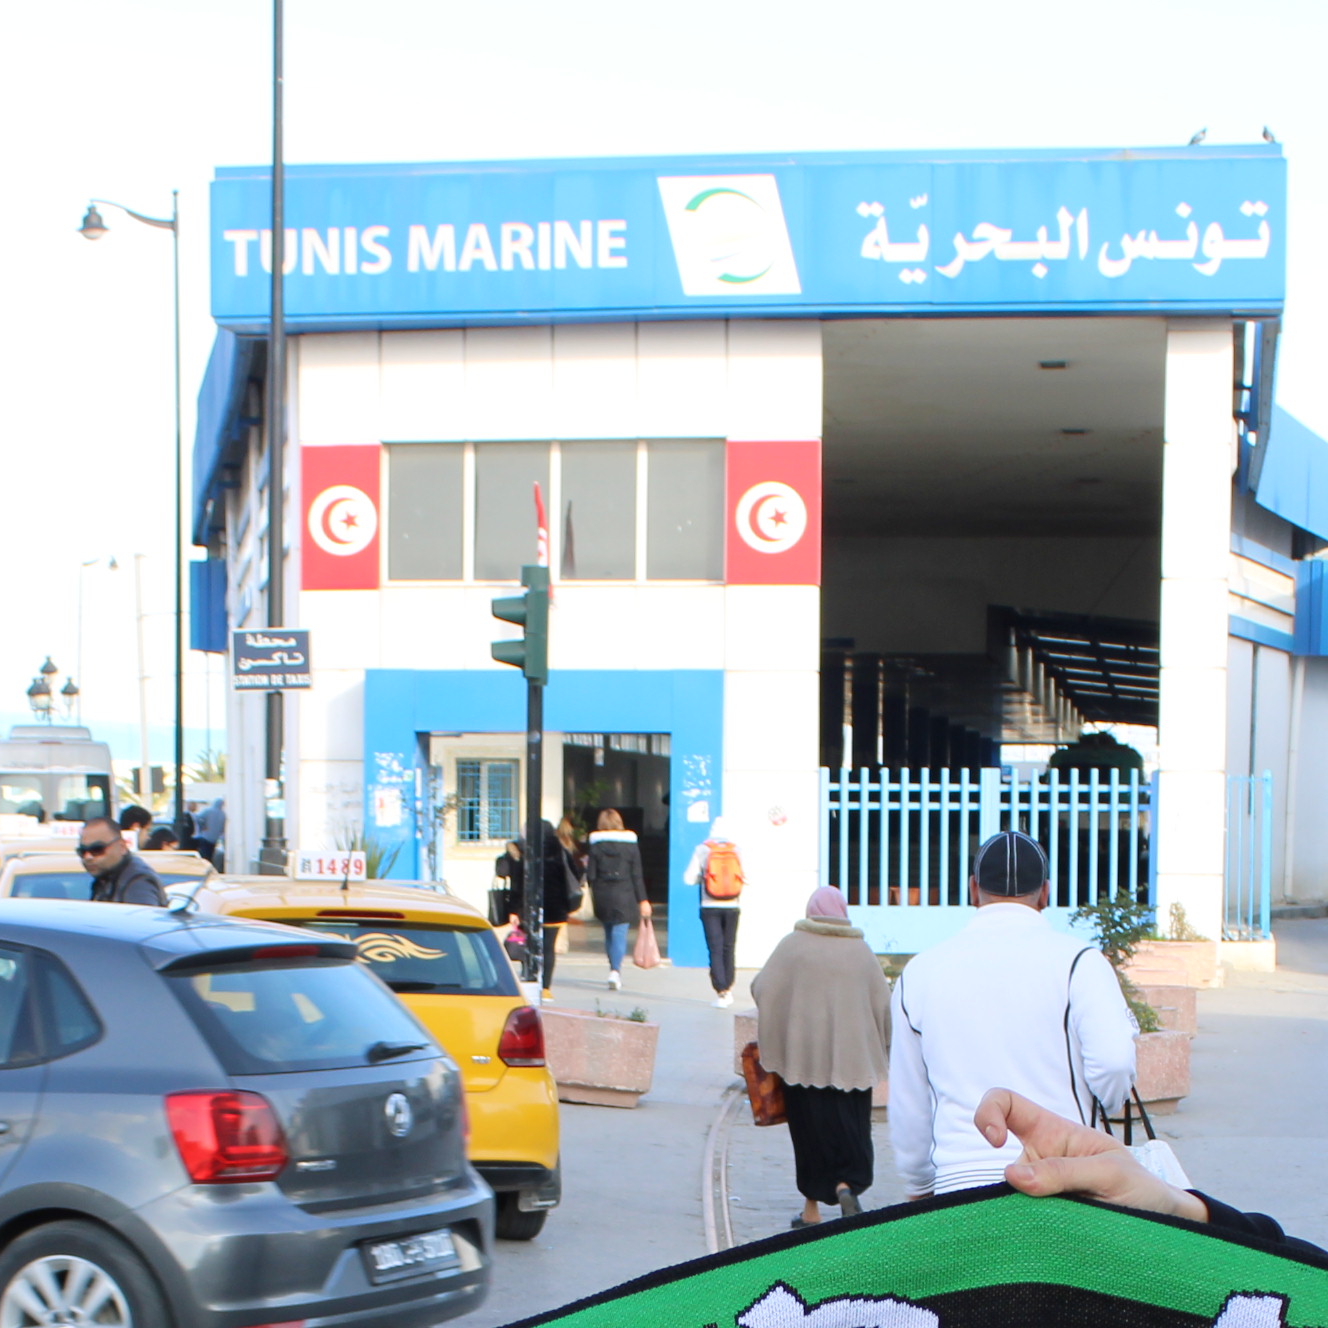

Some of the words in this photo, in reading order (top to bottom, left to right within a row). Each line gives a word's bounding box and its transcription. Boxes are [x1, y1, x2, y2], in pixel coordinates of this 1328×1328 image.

[223, 225, 392, 277] TUNIS
[407, 220, 628, 273] MARINE
[1098, 200, 1270, 278] تونس
[316, 858, 364, 876] 1489
